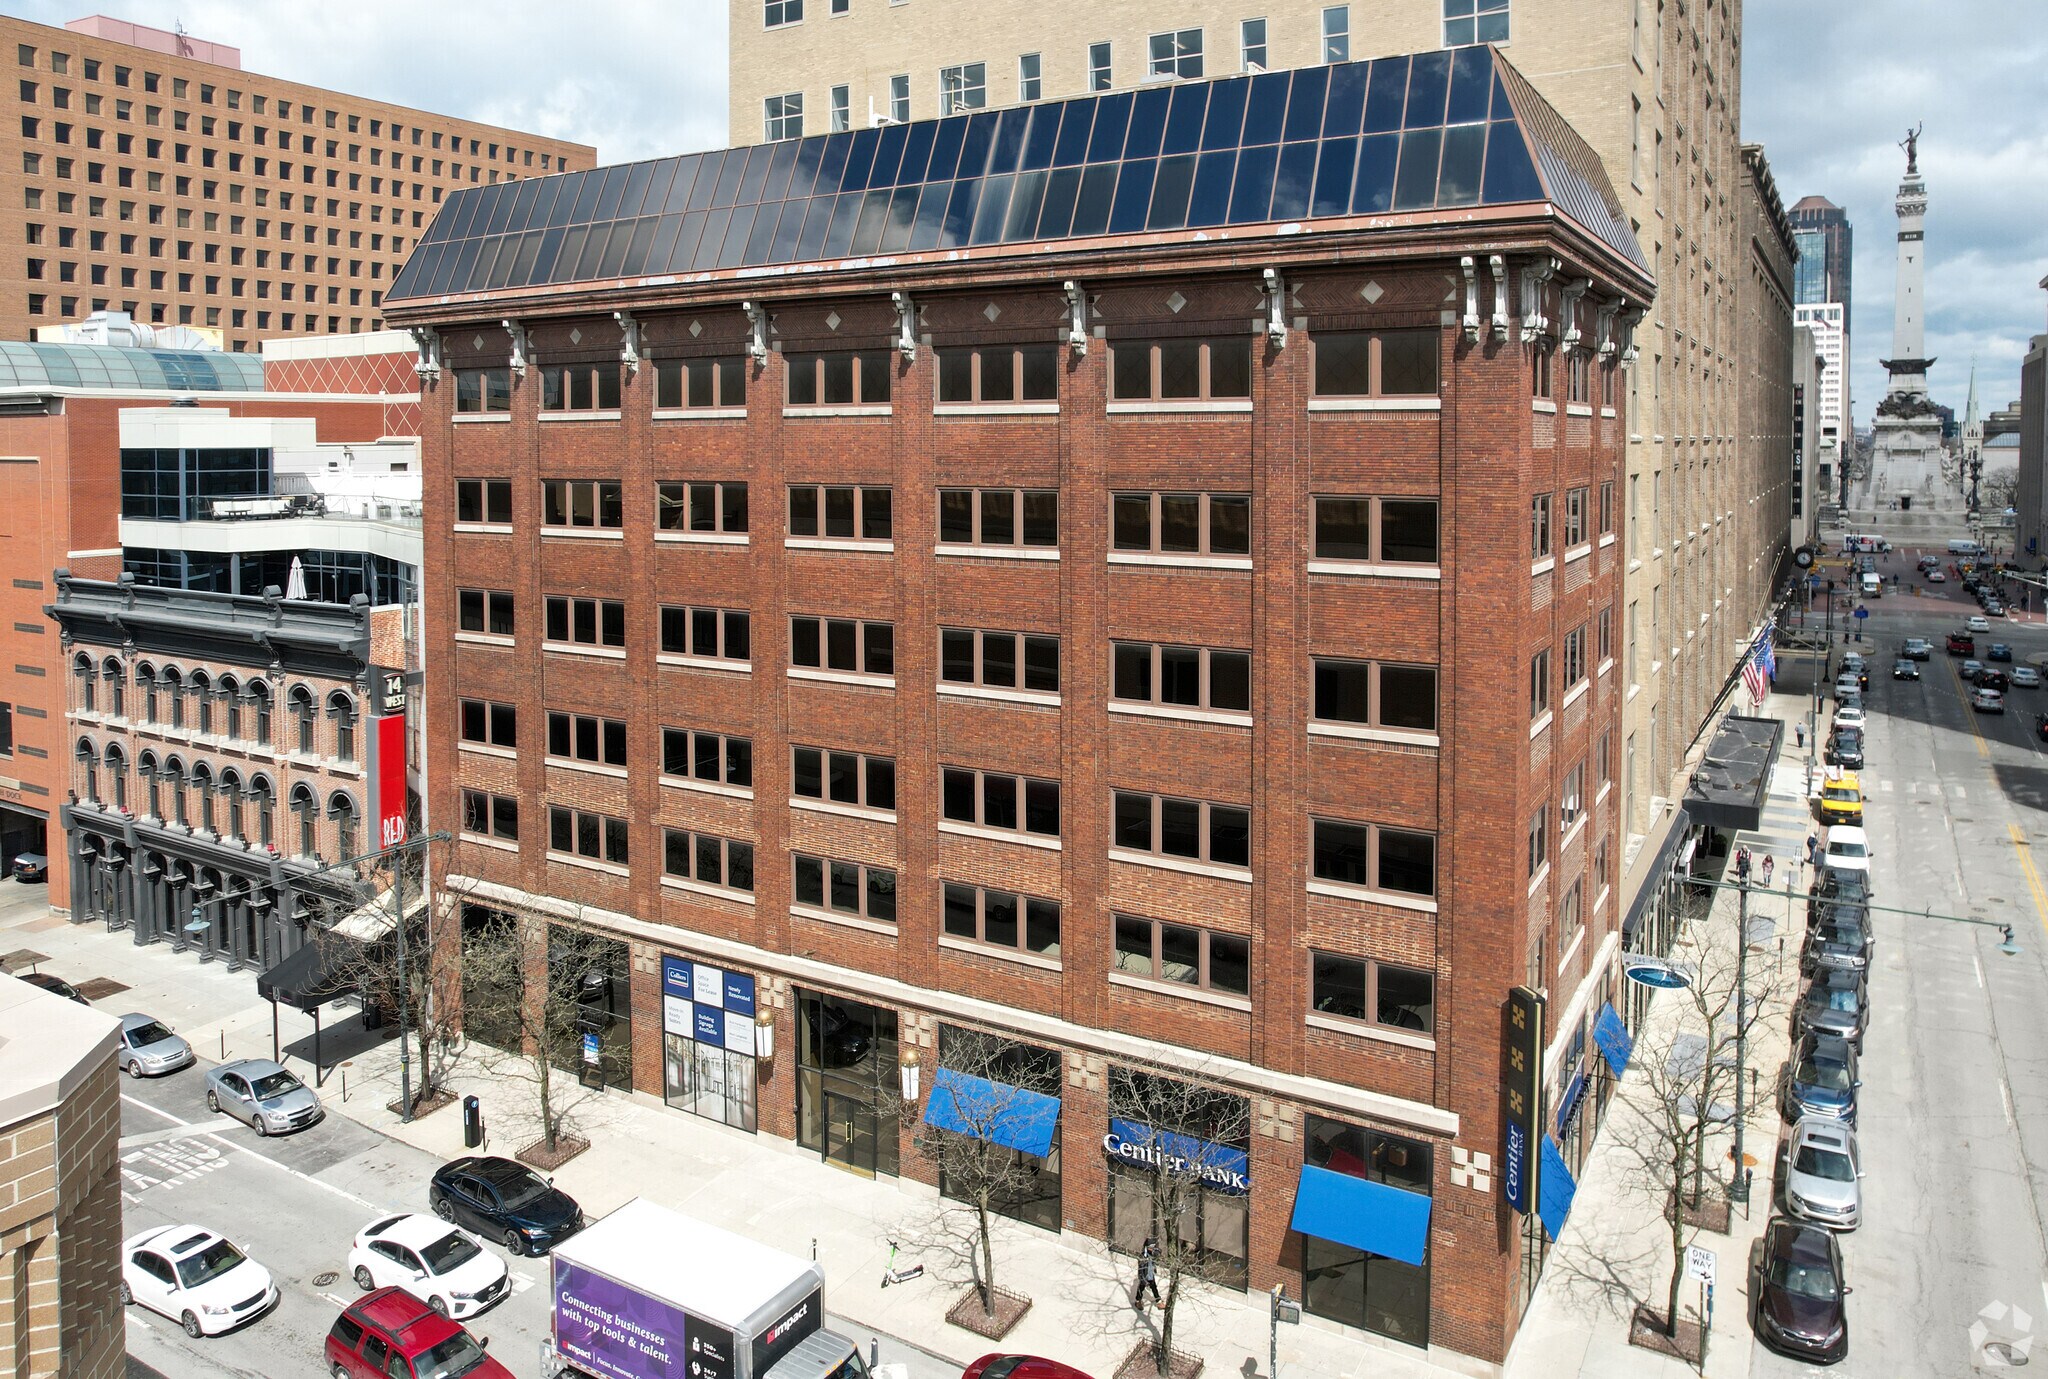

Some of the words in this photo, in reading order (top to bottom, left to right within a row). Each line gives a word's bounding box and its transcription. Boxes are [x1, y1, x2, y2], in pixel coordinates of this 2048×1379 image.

[386, 676, 402, 695] 14
[383, 694, 406, 708] WEST
[383, 815, 405, 847] RED
[669, 971, 687, 981] Colliers
[727, 985, 741, 994] Newly
[728, 991, 751, 1002] Renovated
[698, 1014, 715, 1024] Building
[698, 1026, 718, 1036] Available
[1506, 1125, 1519, 1201] Centier
[1692, 1249, 1711, 1261] ONE
[1692, 1258, 1712, 1270] WAY
[561, 1291, 613, 1325] Connecting
[614, 1314, 666, 1346] businesses
[774, 1302, 808, 1339] impact
[561, 1307, 582, 1323] with
[584, 1317, 600, 1333] top
[602, 1325, 626, 1343] tools
[627, 1336, 637, 1349] &
[639, 1342, 672, 1365] talent.
[567, 1341, 592, 1360] impact
